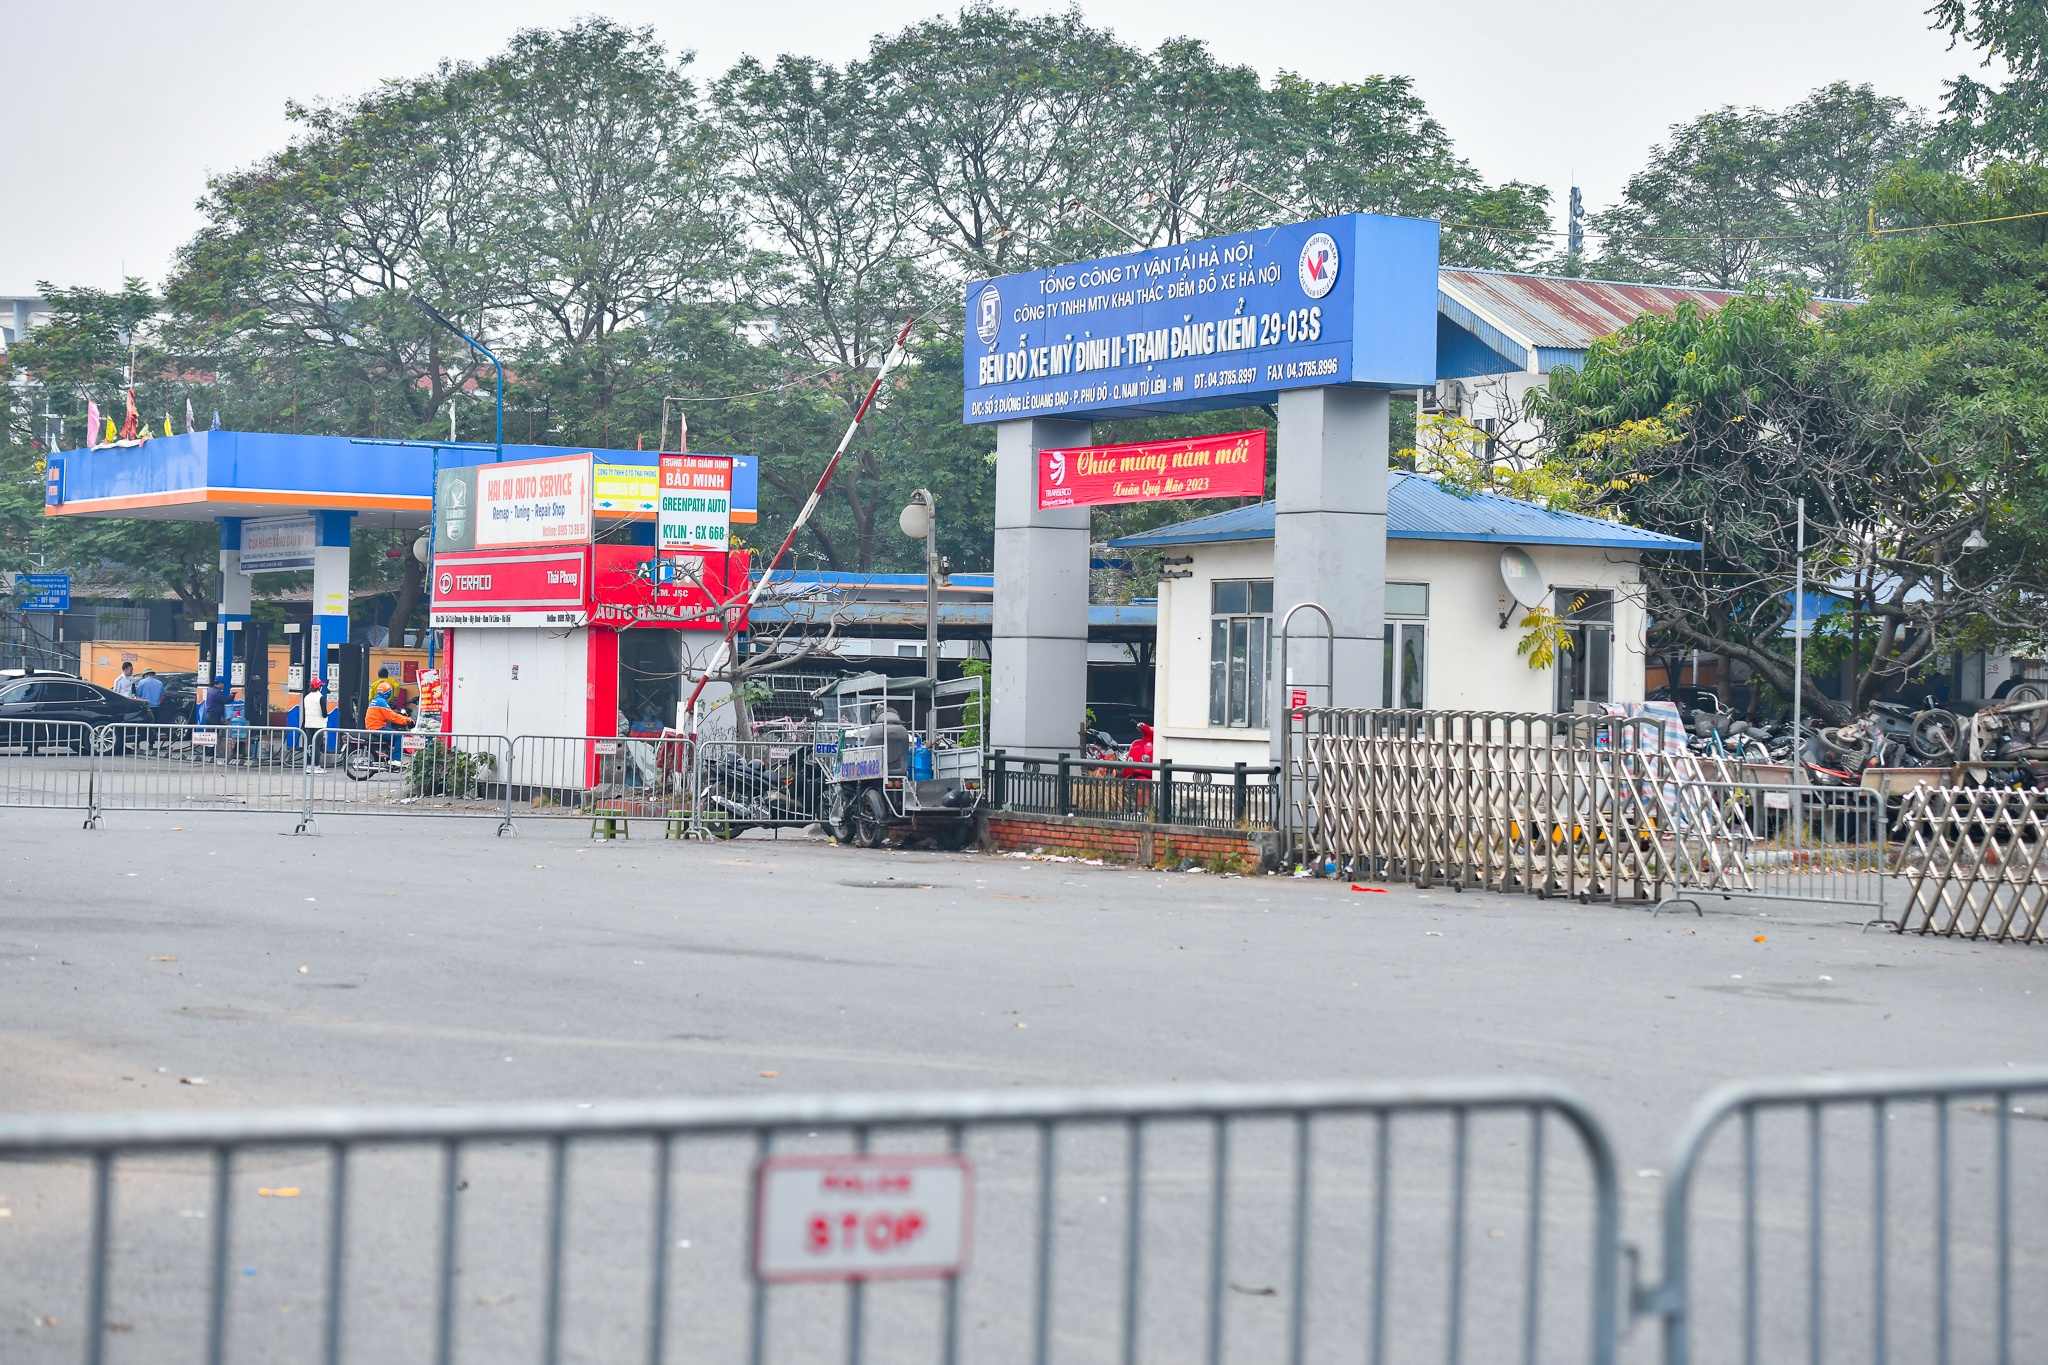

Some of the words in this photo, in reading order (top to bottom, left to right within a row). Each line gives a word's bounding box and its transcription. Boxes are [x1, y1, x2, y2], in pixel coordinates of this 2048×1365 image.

[1040, 269, 1076, 294] TỔNG
[1080, 266, 1122, 288] CÔNG
[1126, 264, 1140, 280] TY
[1144, 256, 1171, 279] VẬN
[1174, 248, 1196, 272] TẢI
[1200, 244, 1220, 267] HÀ
[1224, 240, 1254, 267] NỘI
[1014, 304, 1045, 323] CÔNG
[1047, 302, 1059, 318] TY
[1061, 299, 1086, 316] TNHH
[1088, 295, 1110, 312] MTV
[1112, 292, 1134, 308] KHAI
[1136, 278, 1164, 304] THÁC
[1168, 274, 1195, 299] ĐIỂM
[1198, 269, 1216, 294] ĐỖ
[1221, 274, 1236, 290] XE
[1239, 264, 1256, 287] HÀ
[1258, 262, 1281, 286] NỘI
[979, 342, 1004, 386] BẾN
[1006, 333, 1028, 382] ĐỖ
[1029, 347, 1049, 378] XE
[1050, 334, 1074, 375] MỸ
[1075, 330, 1111, 372] ĐÌNH
[1170, 314, 1215, 358] ĐĂNG
[1218, 297, 1256, 352] KIỂM
[1260, 306, 1322, 346] 29-03S
[1000, 394, 1021, 412] ĐƯỜNG
[1022, 392, 1030, 410] LÊ
[1032, 393, 1054, 409] QUANG
[1055, 391, 1069, 410] ĐẠO
[1140, 376, 1150, 396] TỪ
[1150, 374, 1166, 395] LIÊM
[1173, 376, 1184, 392] HN
[1267, 364, 1284, 381] FAX
[1286, 358, 1338, 378] 04.3785.8996
[662, 458, 682, 467] TRUNG
[684, 457, 696, 468] TÂM
[698, 458, 714, 469] GIÁM
[714, 460, 729, 471] ĐỊNH
[1076, 451, 1116, 476] Chúc
[1120, 448, 1168, 476] mừng
[1172, 445, 1210, 468] năm
[1214, 439, 1250, 465] mới
[488, 479, 500, 501] HAI
[503, 478, 513, 500] AU
[516, 476, 537, 500] AUTO
[539, 472, 573, 498] SERVICE
[666, 469, 690, 486] BẢO
[693, 473, 724, 488] MINH
[1112, 482, 1139, 497] Xuân
[1142, 480, 1161, 497] Quý
[1162, 478, 1185, 493] Mão
[1186, 477, 1210, 492] 2023
[492, 506, 510, 522] Remap
[514, 504, 530, 522] Tuning
[535, 502, 551, 522] Repair
[552, 502, 566, 519] Shop
[662, 497, 706, 512] GREENPATH
[707, 498, 726, 513] AUTO
[663, 525, 687, 539] KYLIN
[695, 526, 708, 540] GX
[709, 526, 724, 540] 668
[456, 574, 492, 591] TERACO
[546, 570, 558, 584] Thái
[560, 572, 578, 587] Phong
[596, 603, 632, 620] AUTO
[807, 1211, 925, 1254] STOP
